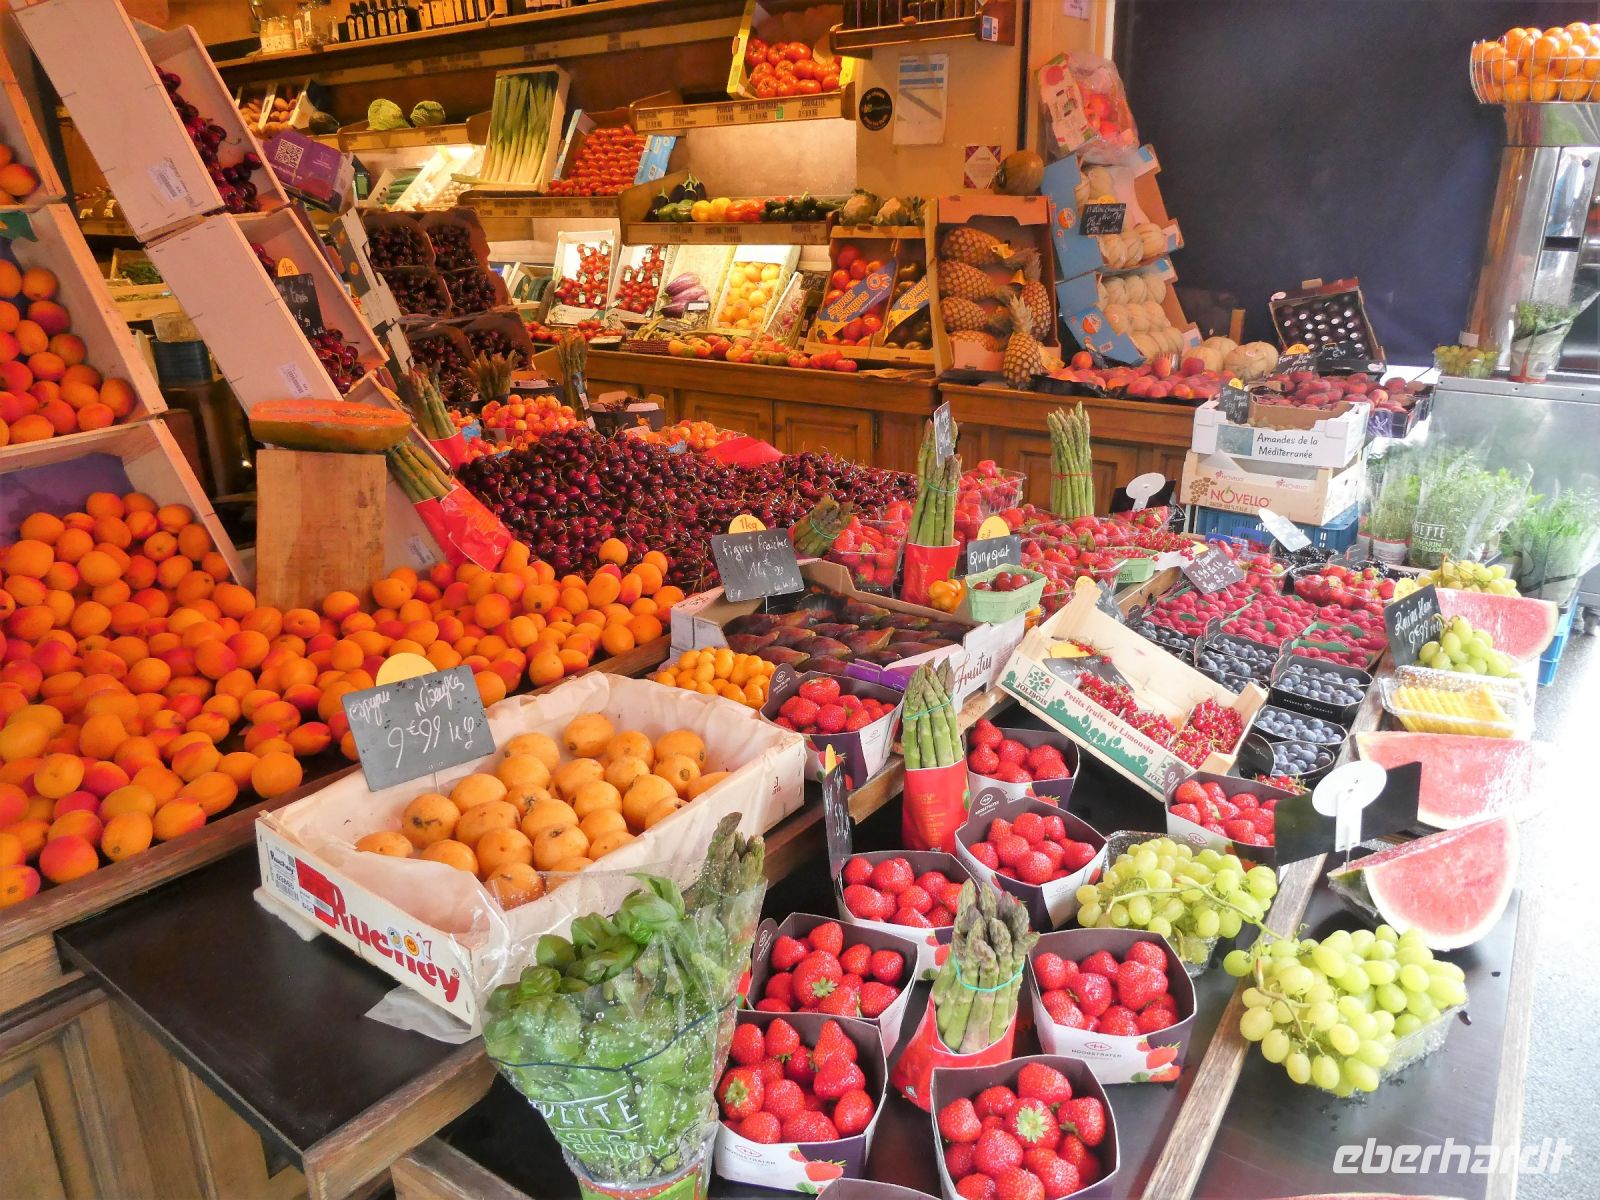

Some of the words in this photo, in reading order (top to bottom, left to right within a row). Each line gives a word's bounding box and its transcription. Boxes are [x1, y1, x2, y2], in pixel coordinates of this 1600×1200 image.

[1257, 433, 1296, 445] Amandes
[1298, 437, 1309, 445] de
[1310, 436, 1318, 446] la
[1258, 446, 1313, 459] Méditerranée
[1210, 487, 1271, 508] NOVELLO
[1015, 683, 1049, 706] JOLIBOIS
[1064, 689, 1085, 709] Petits
[1086, 704, 1107, 724] fruits
[1108, 720, 1118, 731] du
[1119, 728, 1155, 755] Limousin
[388, 715, 441, 769] 9€99
[558, 1132, 622, 1145] ASILIC
[562, 1135, 666, 1160] ASILICUM
